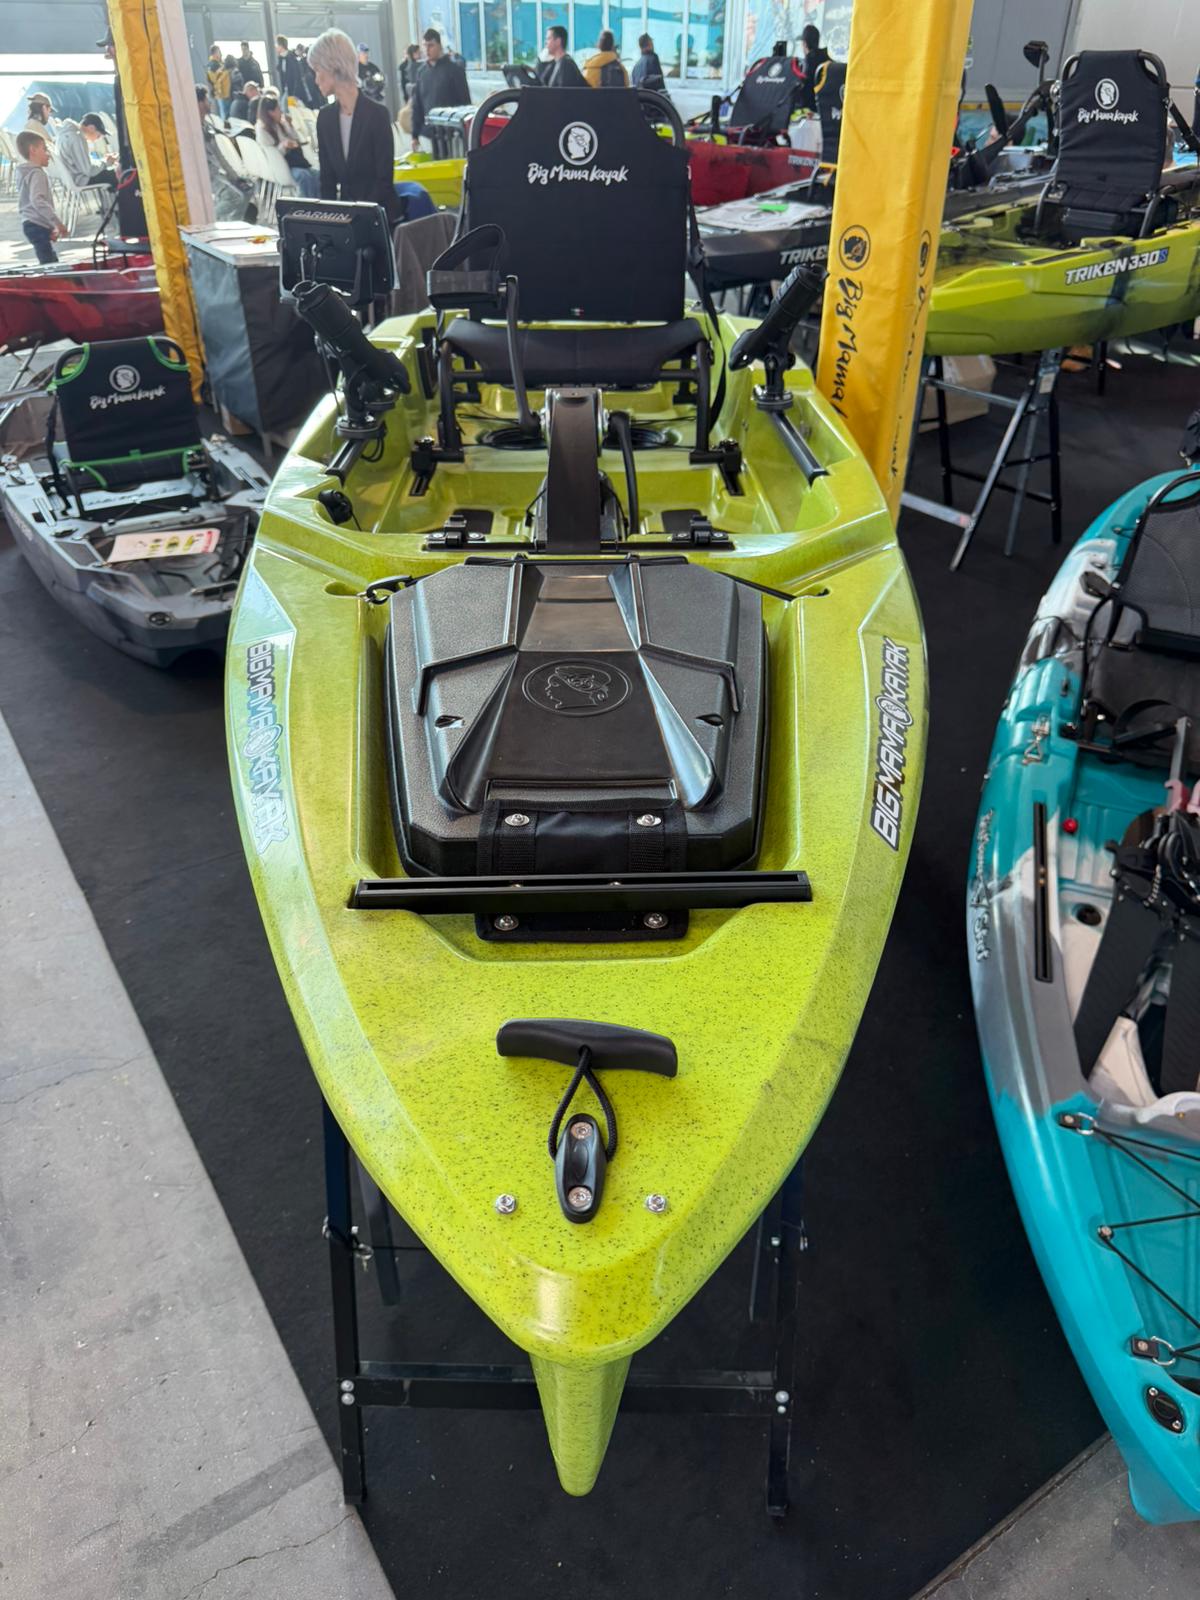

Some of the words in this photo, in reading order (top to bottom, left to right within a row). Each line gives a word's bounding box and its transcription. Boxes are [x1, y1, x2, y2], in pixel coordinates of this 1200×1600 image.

[1077, 107, 1090, 123] Big
[1090, 108, 1114, 121] Mama
[527, 162, 549, 185] Big
[549, 163, 589, 182] Mama
[292, 209, 350, 221] GARMIN
[780, 244, 828, 265] TRIKE
[1065, 257, 1128, 285] TRIKEN
[1127, 248, 1169, 271] 330S
[836, 277, 864, 319] Big
[832, 323, 858, 404] Mama
[90, 395, 107, 410] Big
